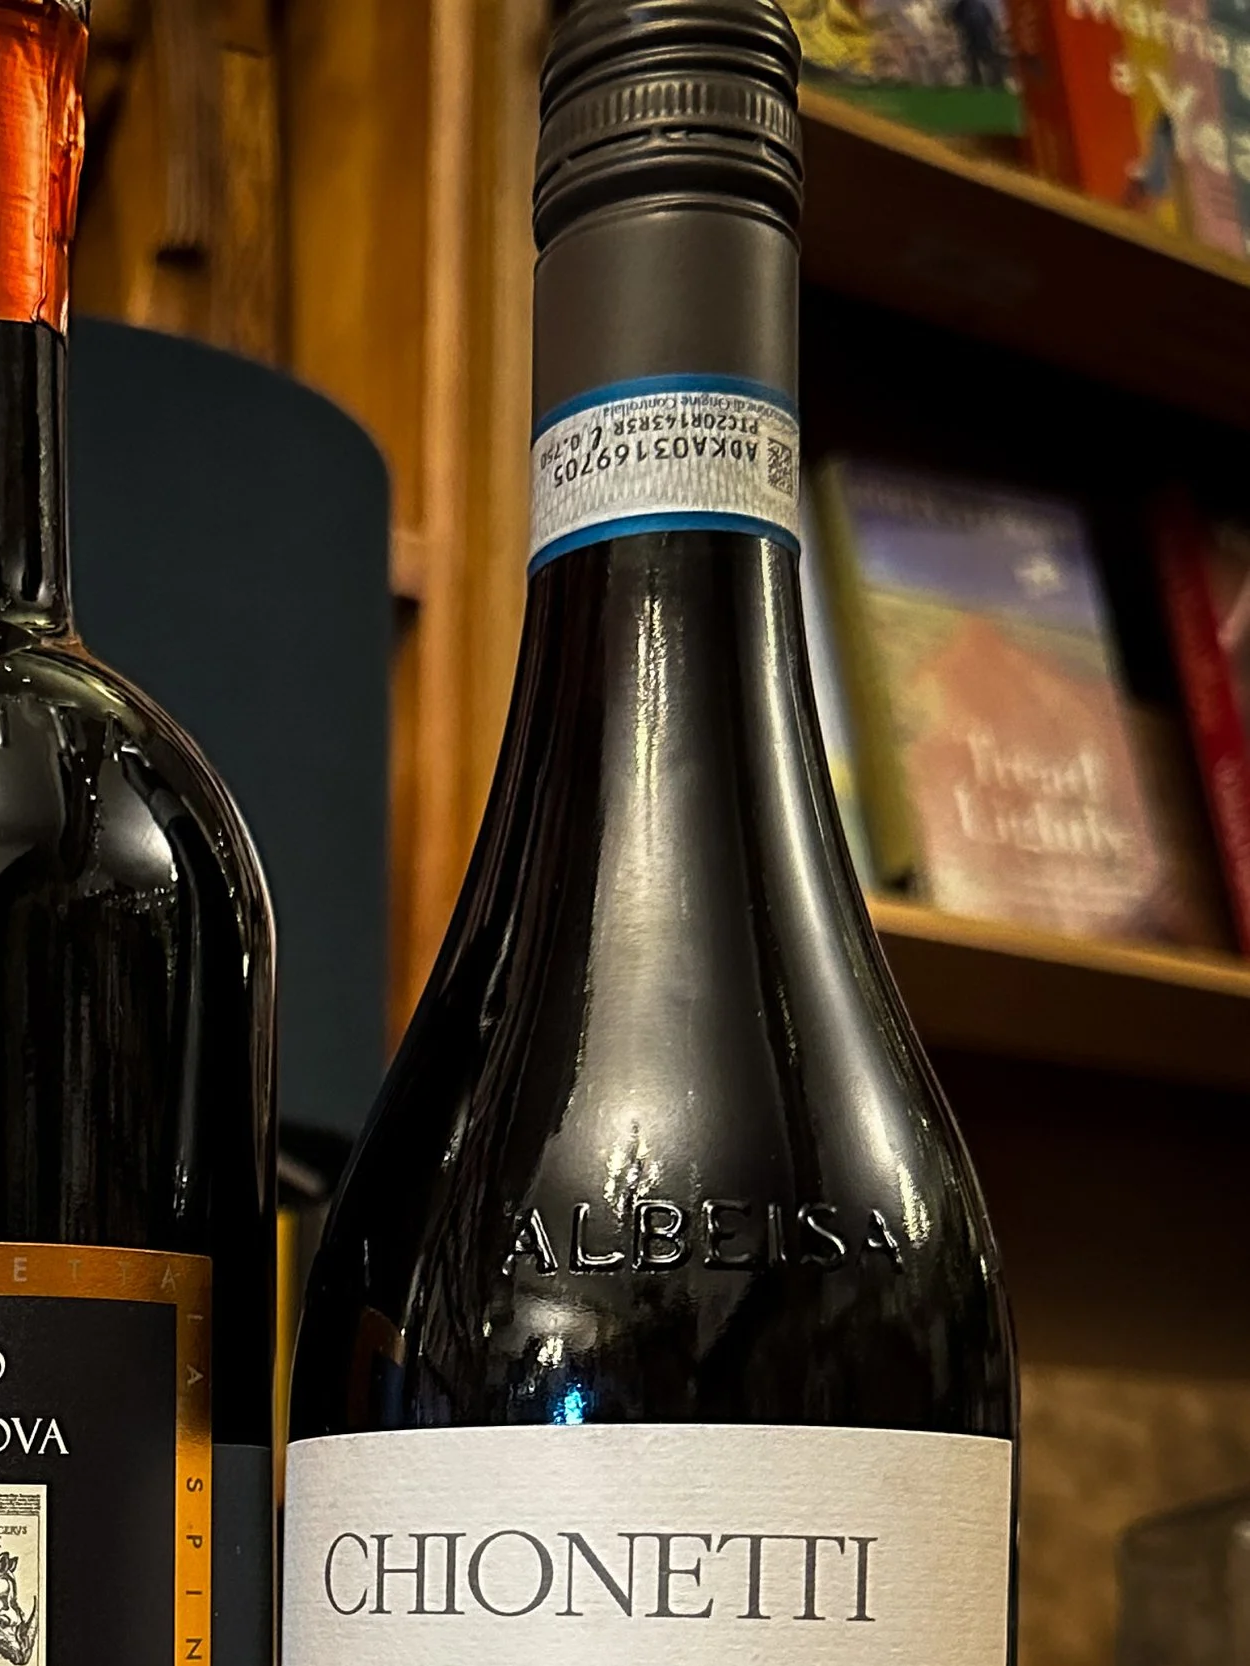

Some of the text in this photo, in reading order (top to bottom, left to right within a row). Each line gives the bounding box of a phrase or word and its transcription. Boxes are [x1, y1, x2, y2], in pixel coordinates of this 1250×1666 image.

[554, 437, 758, 488] ADKA03169705
[502, 1198, 906, 1277] ALBEISA
[324, 1529, 879, 1623] CHIONETTI
